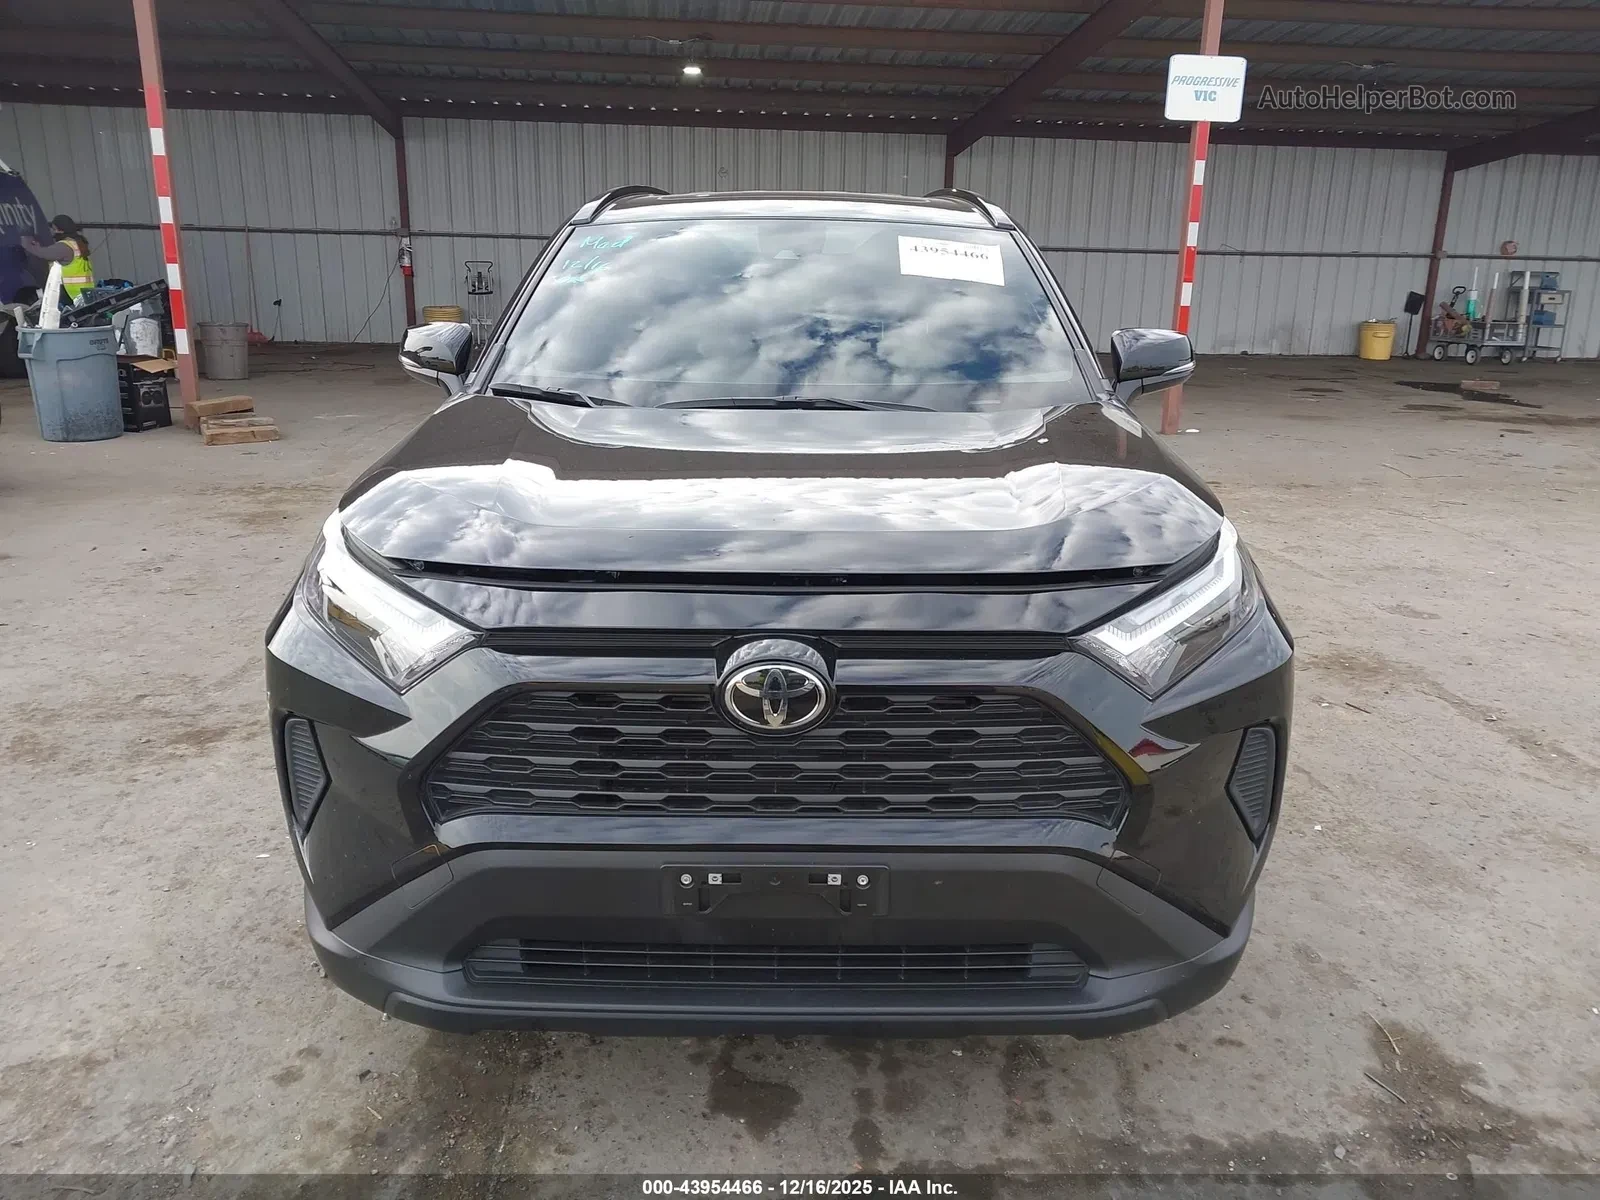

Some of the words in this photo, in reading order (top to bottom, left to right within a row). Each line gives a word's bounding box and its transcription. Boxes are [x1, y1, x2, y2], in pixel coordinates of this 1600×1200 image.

[1171, 75, 1241, 88] PROGRESSIVE
[1194, 89, 1218, 102] VIC
[0, 196, 37, 234] inity
[910, 245, 989, 260] 43954466
